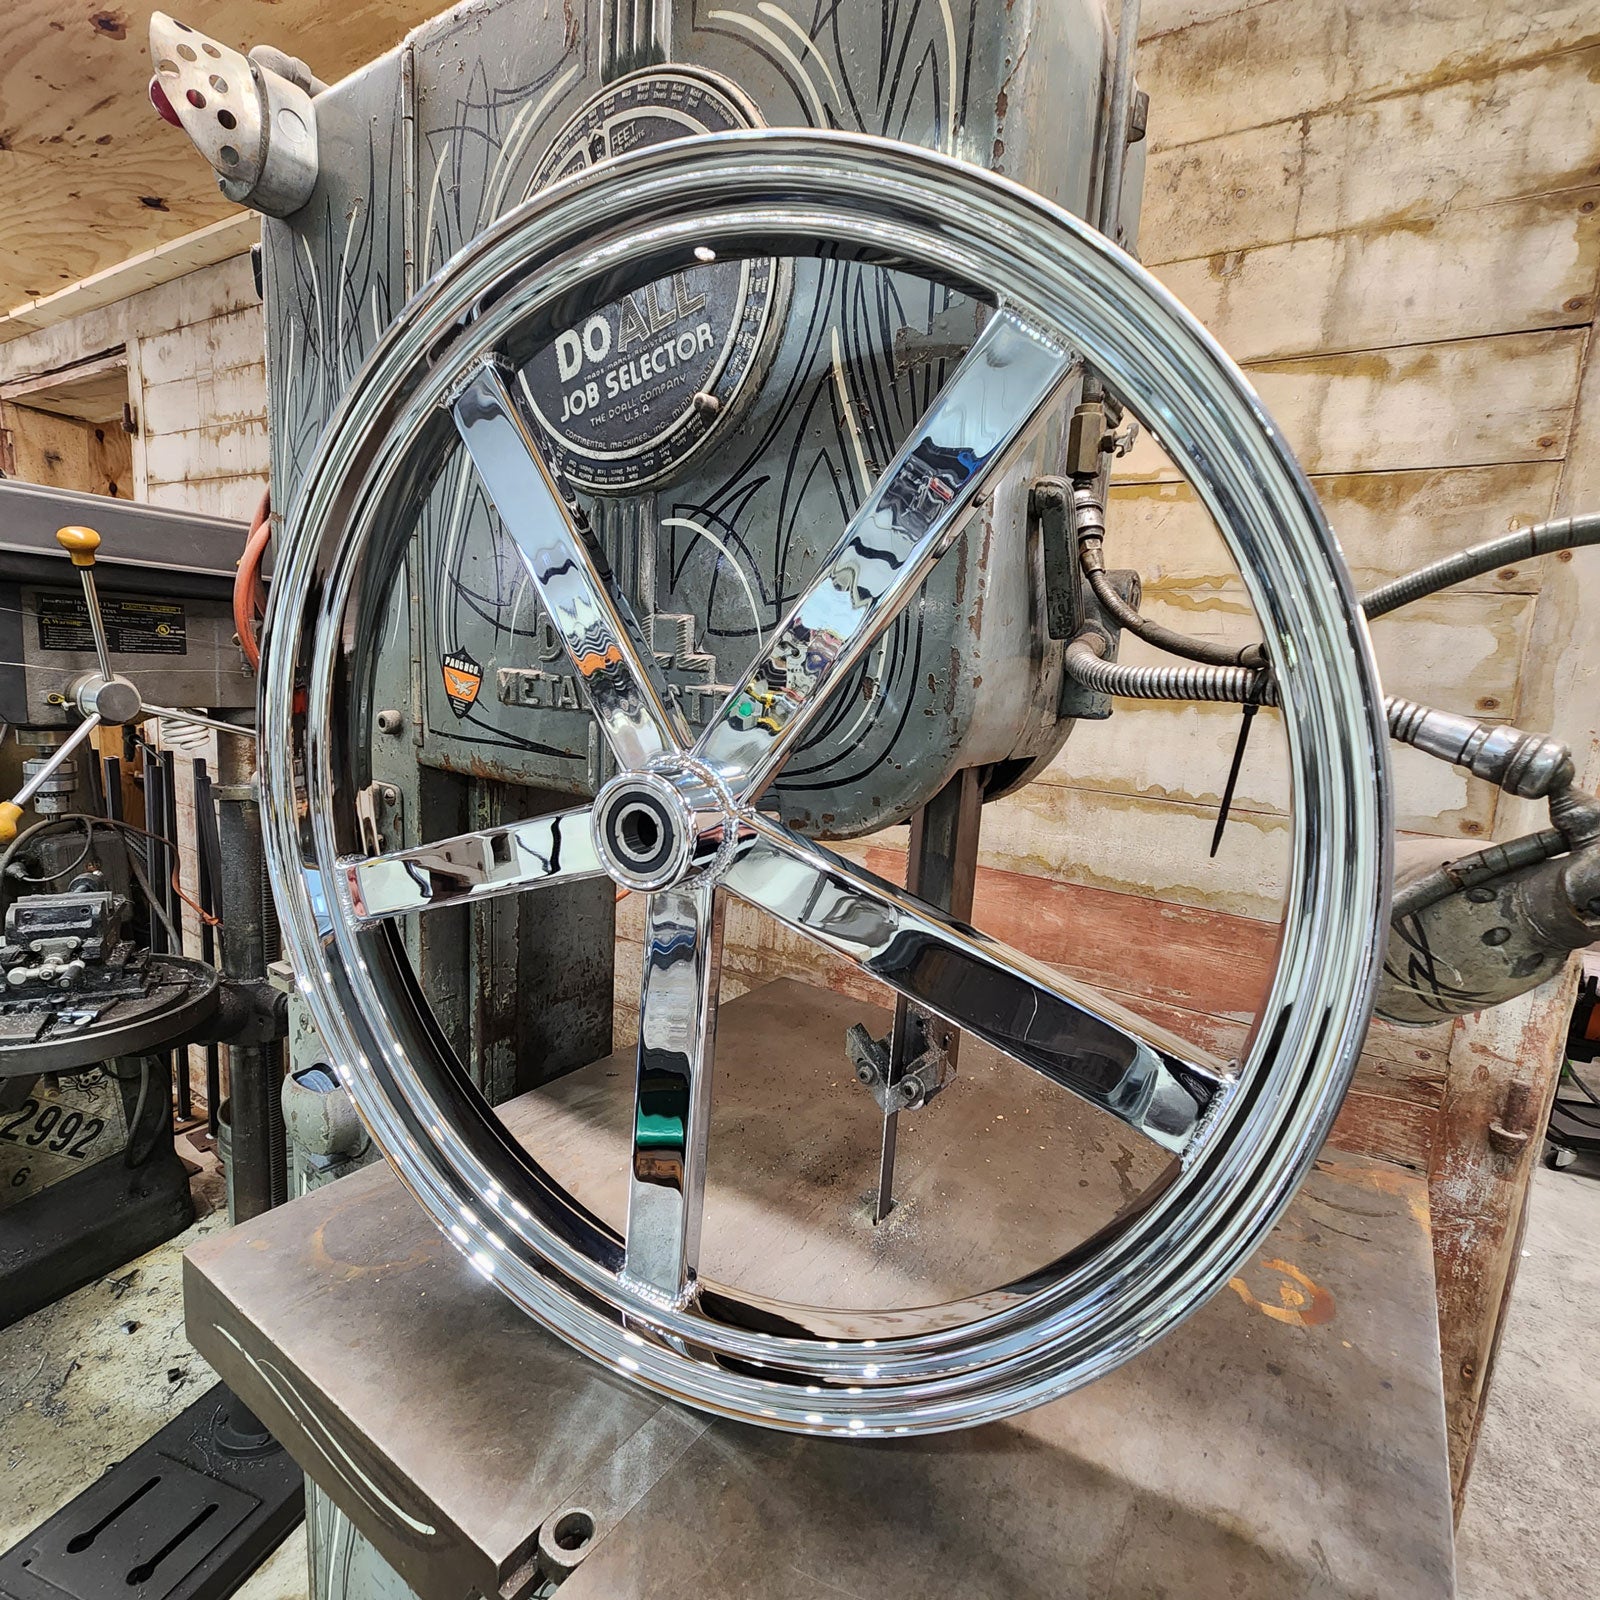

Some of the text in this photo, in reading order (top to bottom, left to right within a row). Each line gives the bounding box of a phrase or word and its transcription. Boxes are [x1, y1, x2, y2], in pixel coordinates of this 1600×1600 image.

[611, 121, 636, 150] FEET
[624, 129, 646, 149] MINUTE
[634, 330, 677, 355] REGISTERED
[560, 322, 715, 423] JOB SELECTOR
[590, 373, 687, 428] THE DOALL COMPANY
[565, 428, 607, 449] CONTINENTAL
[0, 1098, 105, 1160] 2992
[11, 1167, 32, 1188] 6
